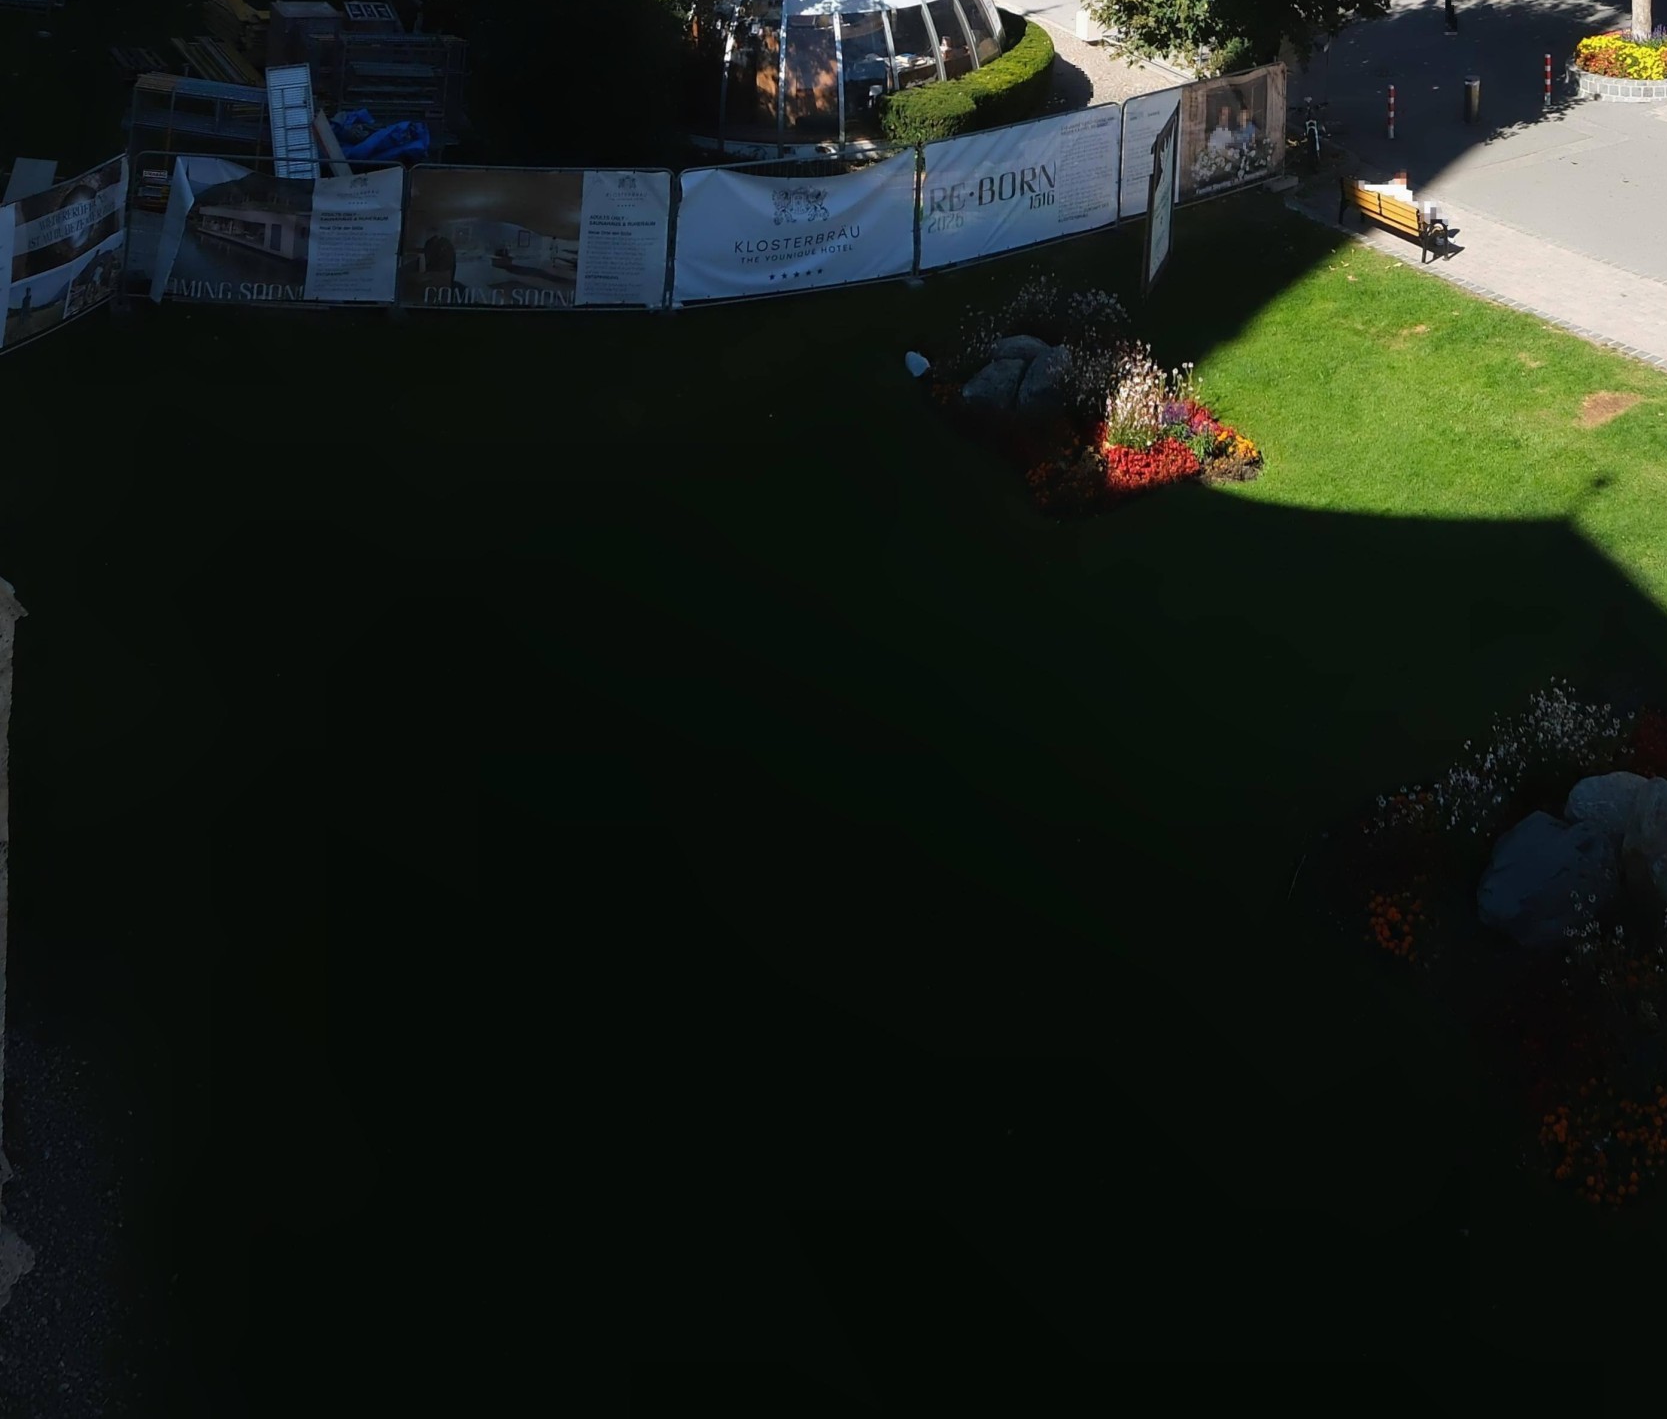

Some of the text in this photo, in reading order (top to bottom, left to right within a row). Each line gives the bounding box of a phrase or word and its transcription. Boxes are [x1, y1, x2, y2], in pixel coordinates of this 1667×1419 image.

[1029, 190, 1055, 210] 1516
[735, 225, 861, 254] KLOSTERBRÄU
[740, 244, 853, 264] THE YOUNIQUE HOTEL
